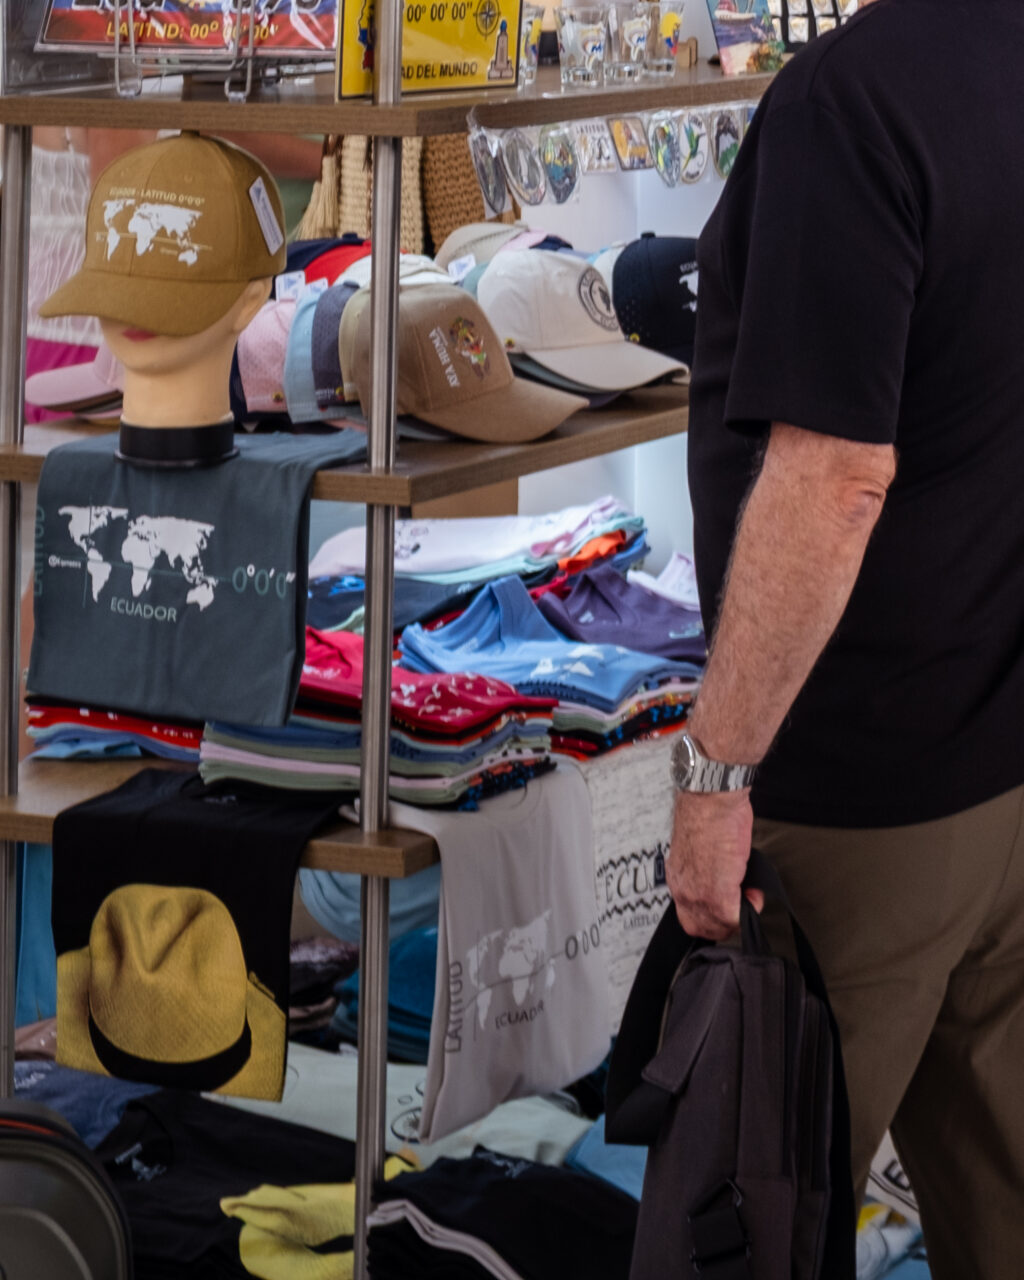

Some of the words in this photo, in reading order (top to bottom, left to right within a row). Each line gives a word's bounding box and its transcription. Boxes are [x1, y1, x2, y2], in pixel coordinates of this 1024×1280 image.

[416, 64, 437, 79] DEL
[439, 62, 478, 77] MUNDO
[141, 188, 177, 202] LATITUD
[111, 597, 177, 622] ECUADOR
